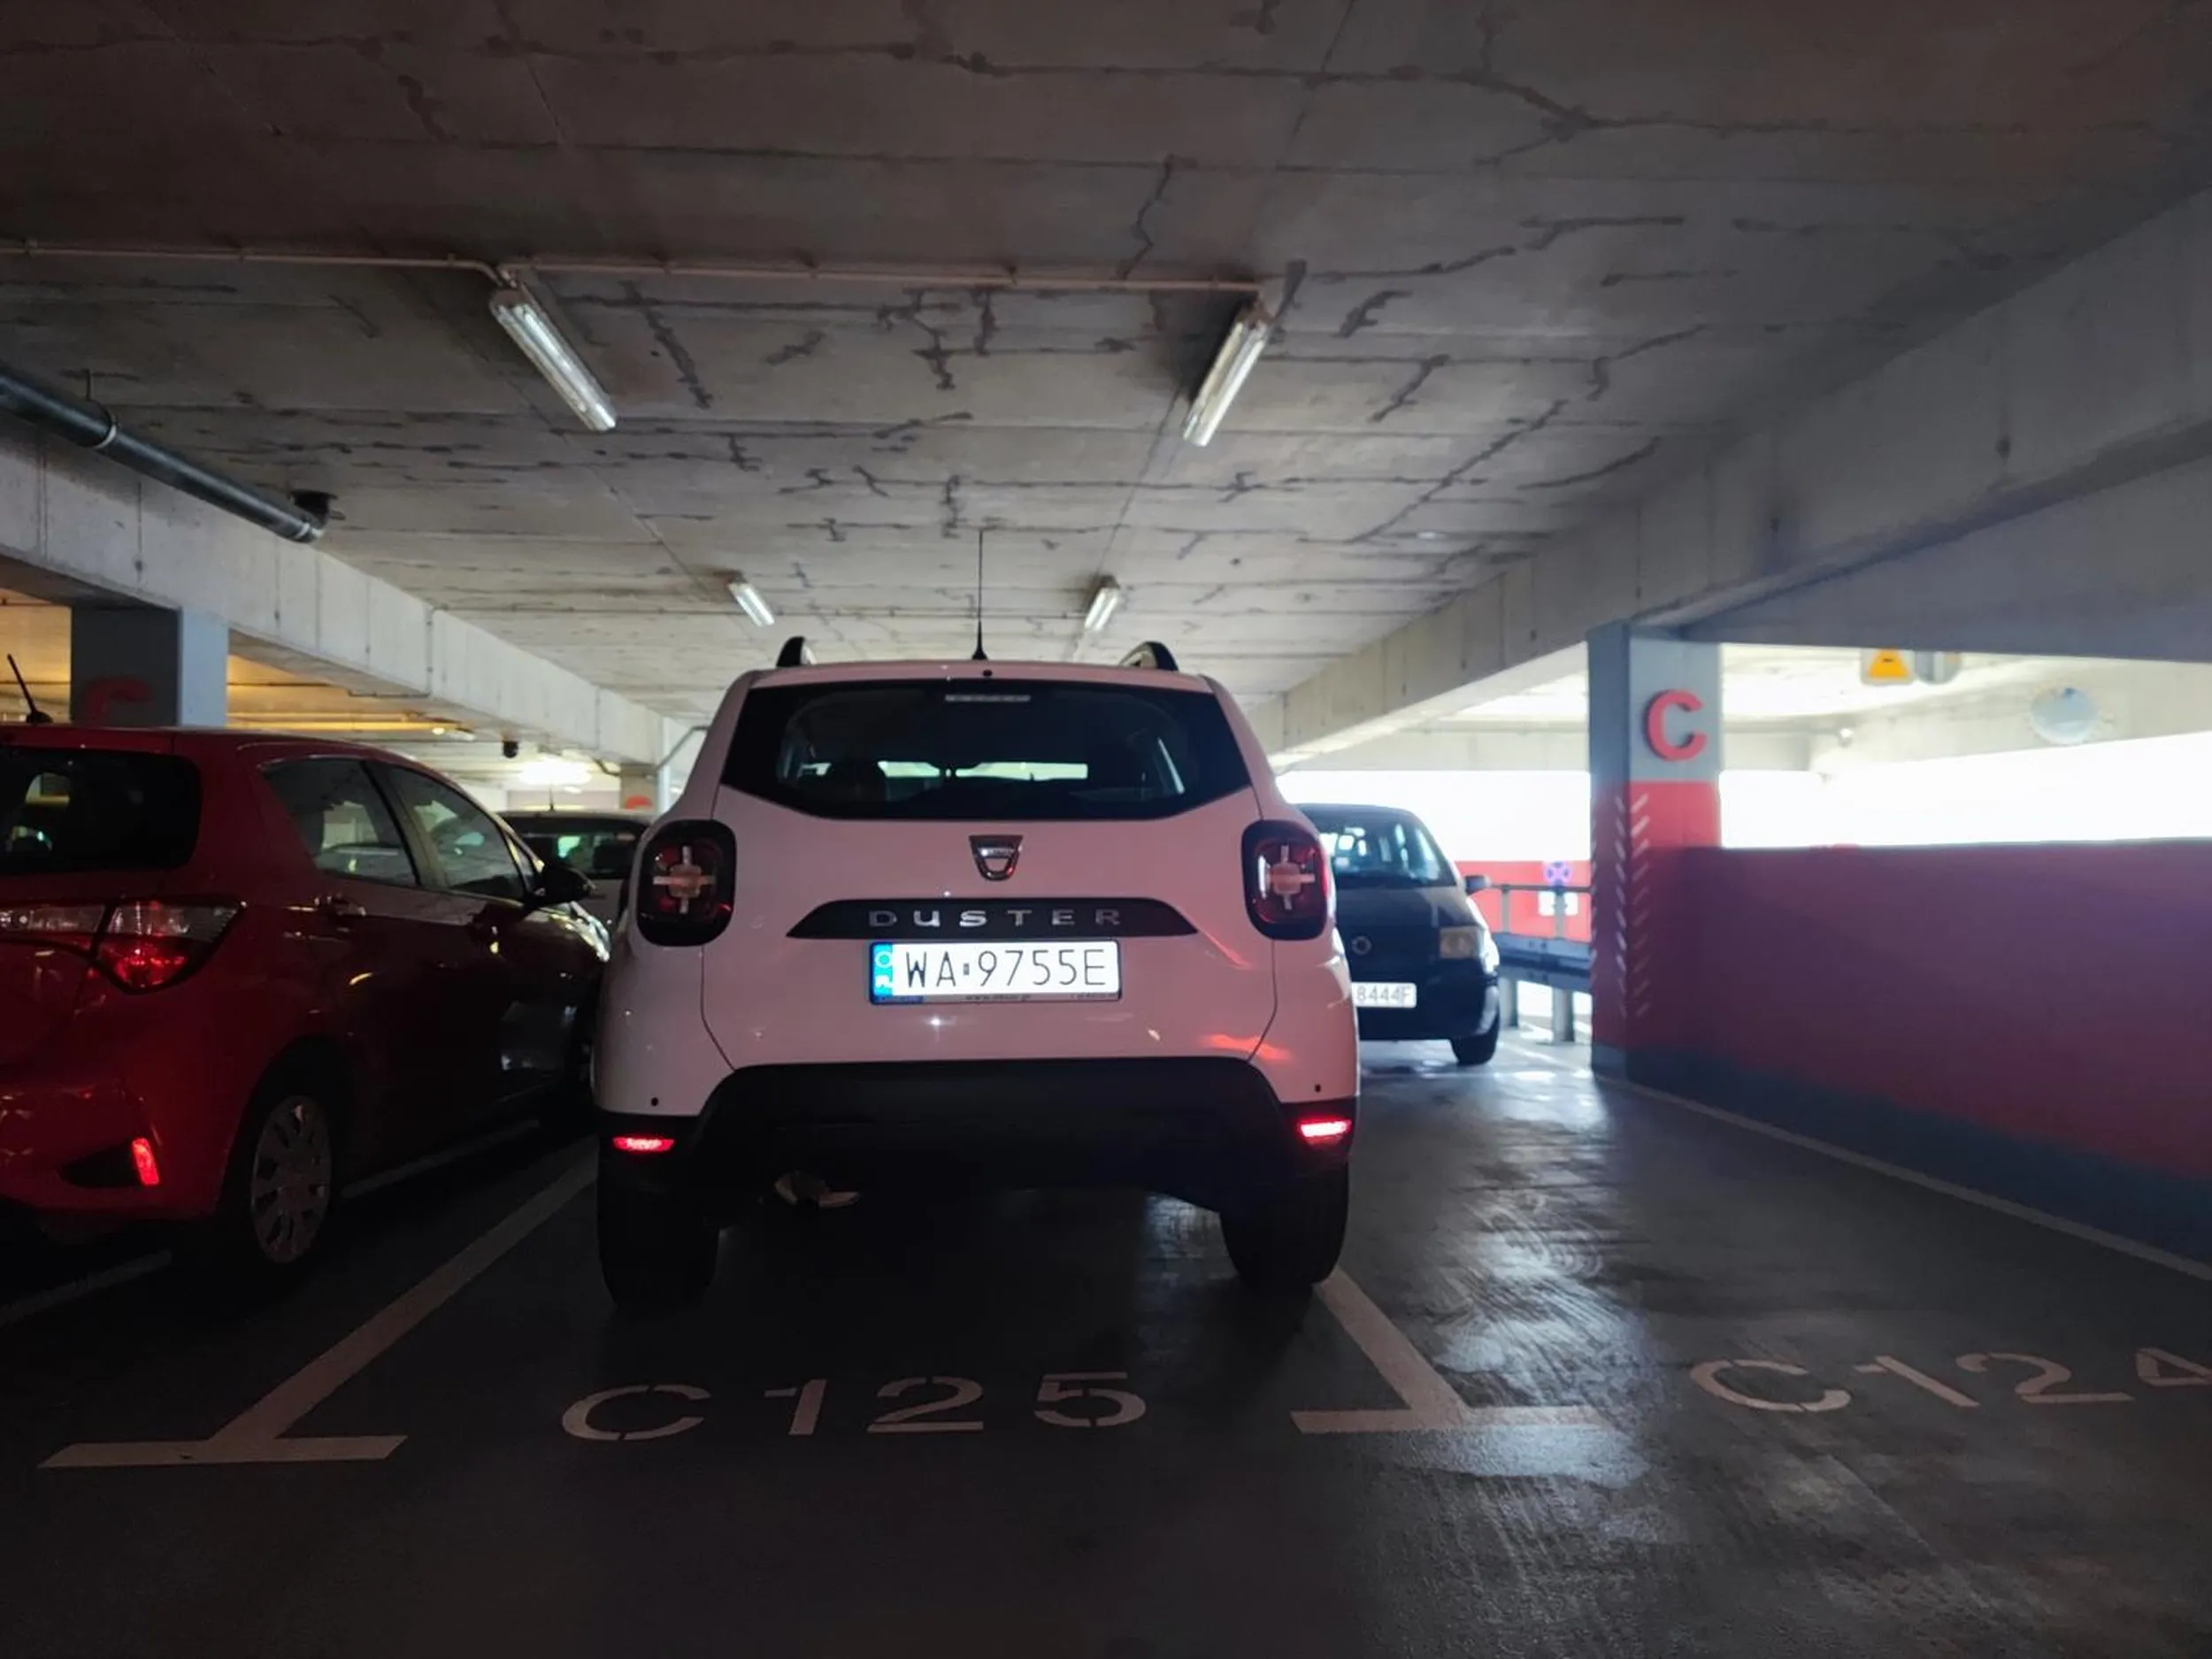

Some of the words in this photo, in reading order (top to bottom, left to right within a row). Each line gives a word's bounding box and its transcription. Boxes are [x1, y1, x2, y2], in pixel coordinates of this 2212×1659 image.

[1644, 689, 1707, 761] C
[870, 909, 1120, 927] DUSTER
[906, 950, 956, 987] WA
[978, 949, 1105, 987] 9755E
